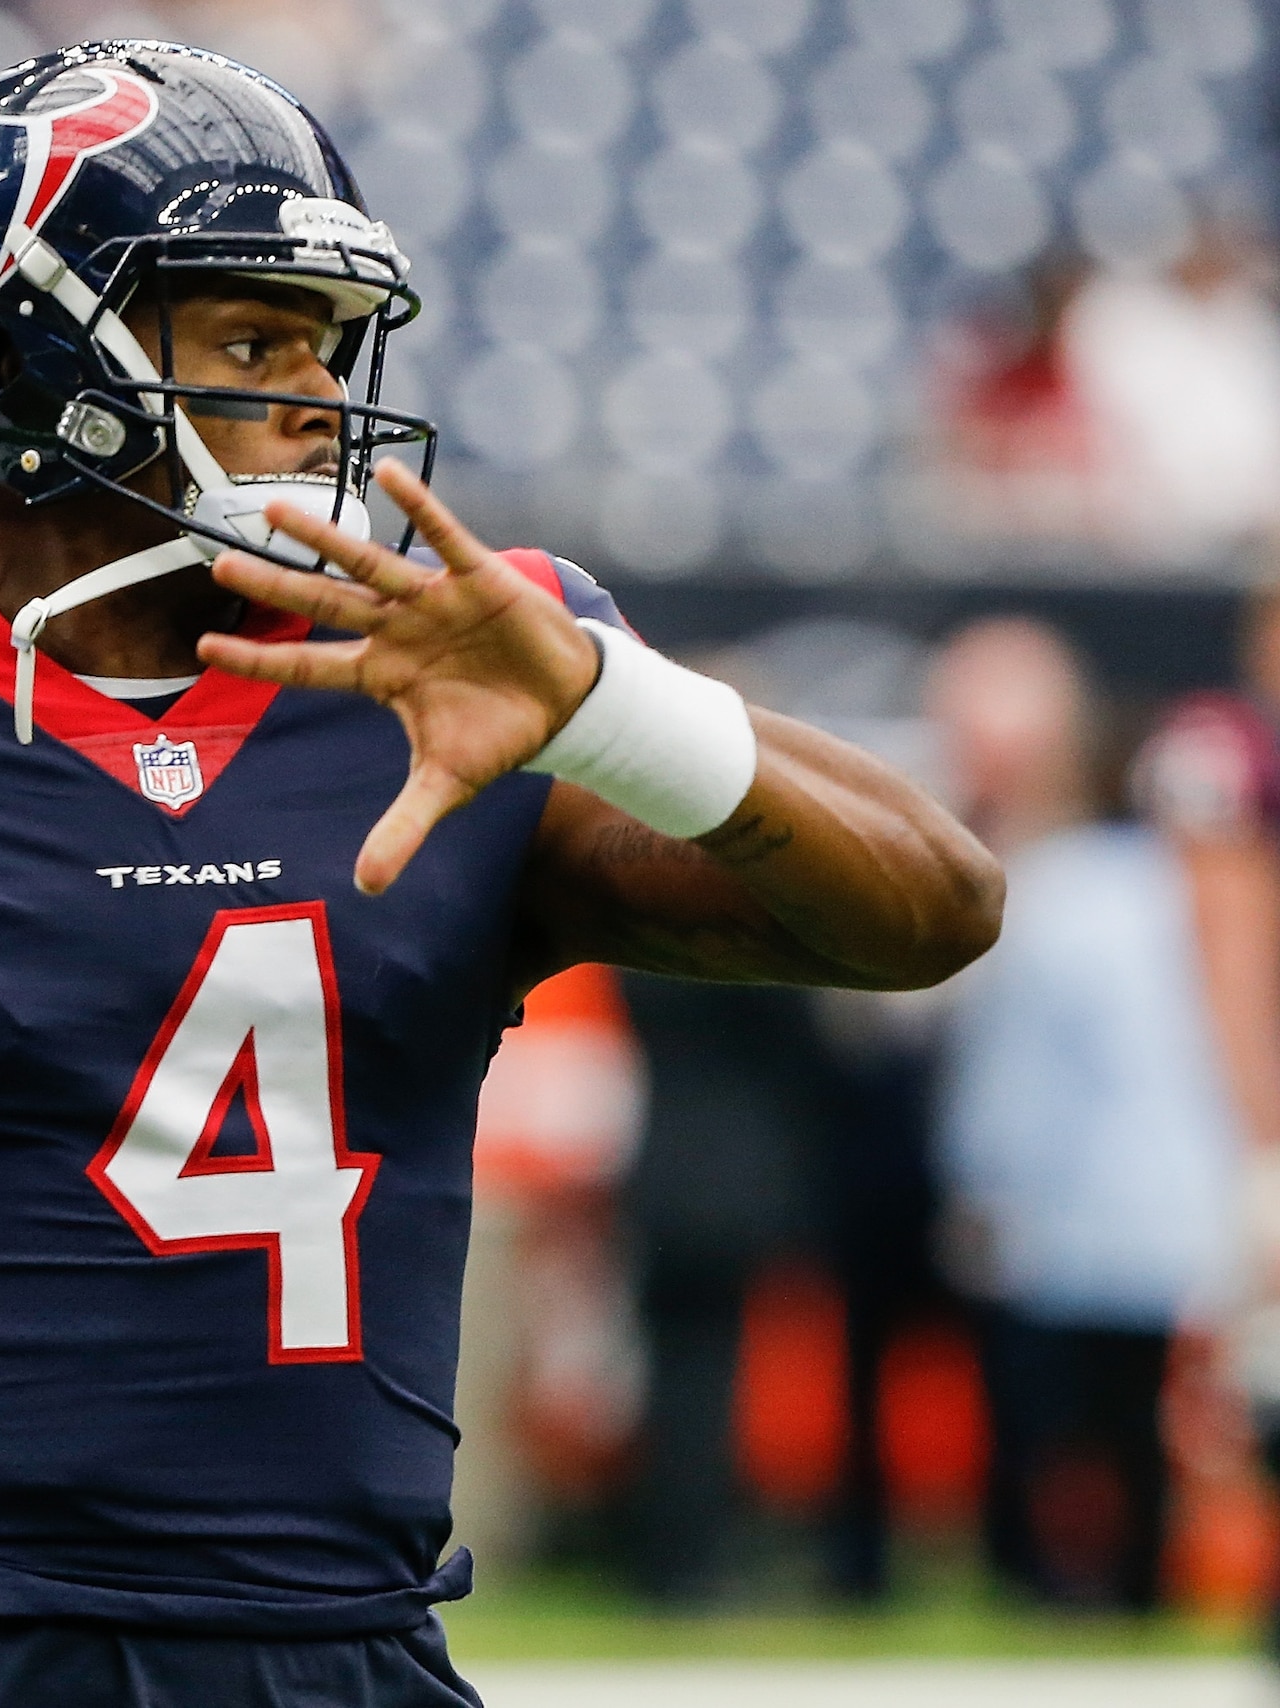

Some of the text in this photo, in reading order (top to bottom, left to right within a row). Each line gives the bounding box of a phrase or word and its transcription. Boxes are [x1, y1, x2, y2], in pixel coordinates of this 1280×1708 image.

[151, 767, 192, 792] NFL
[95, 859, 282, 889] TEXANS
[85, 900, 383, 1366] 4
